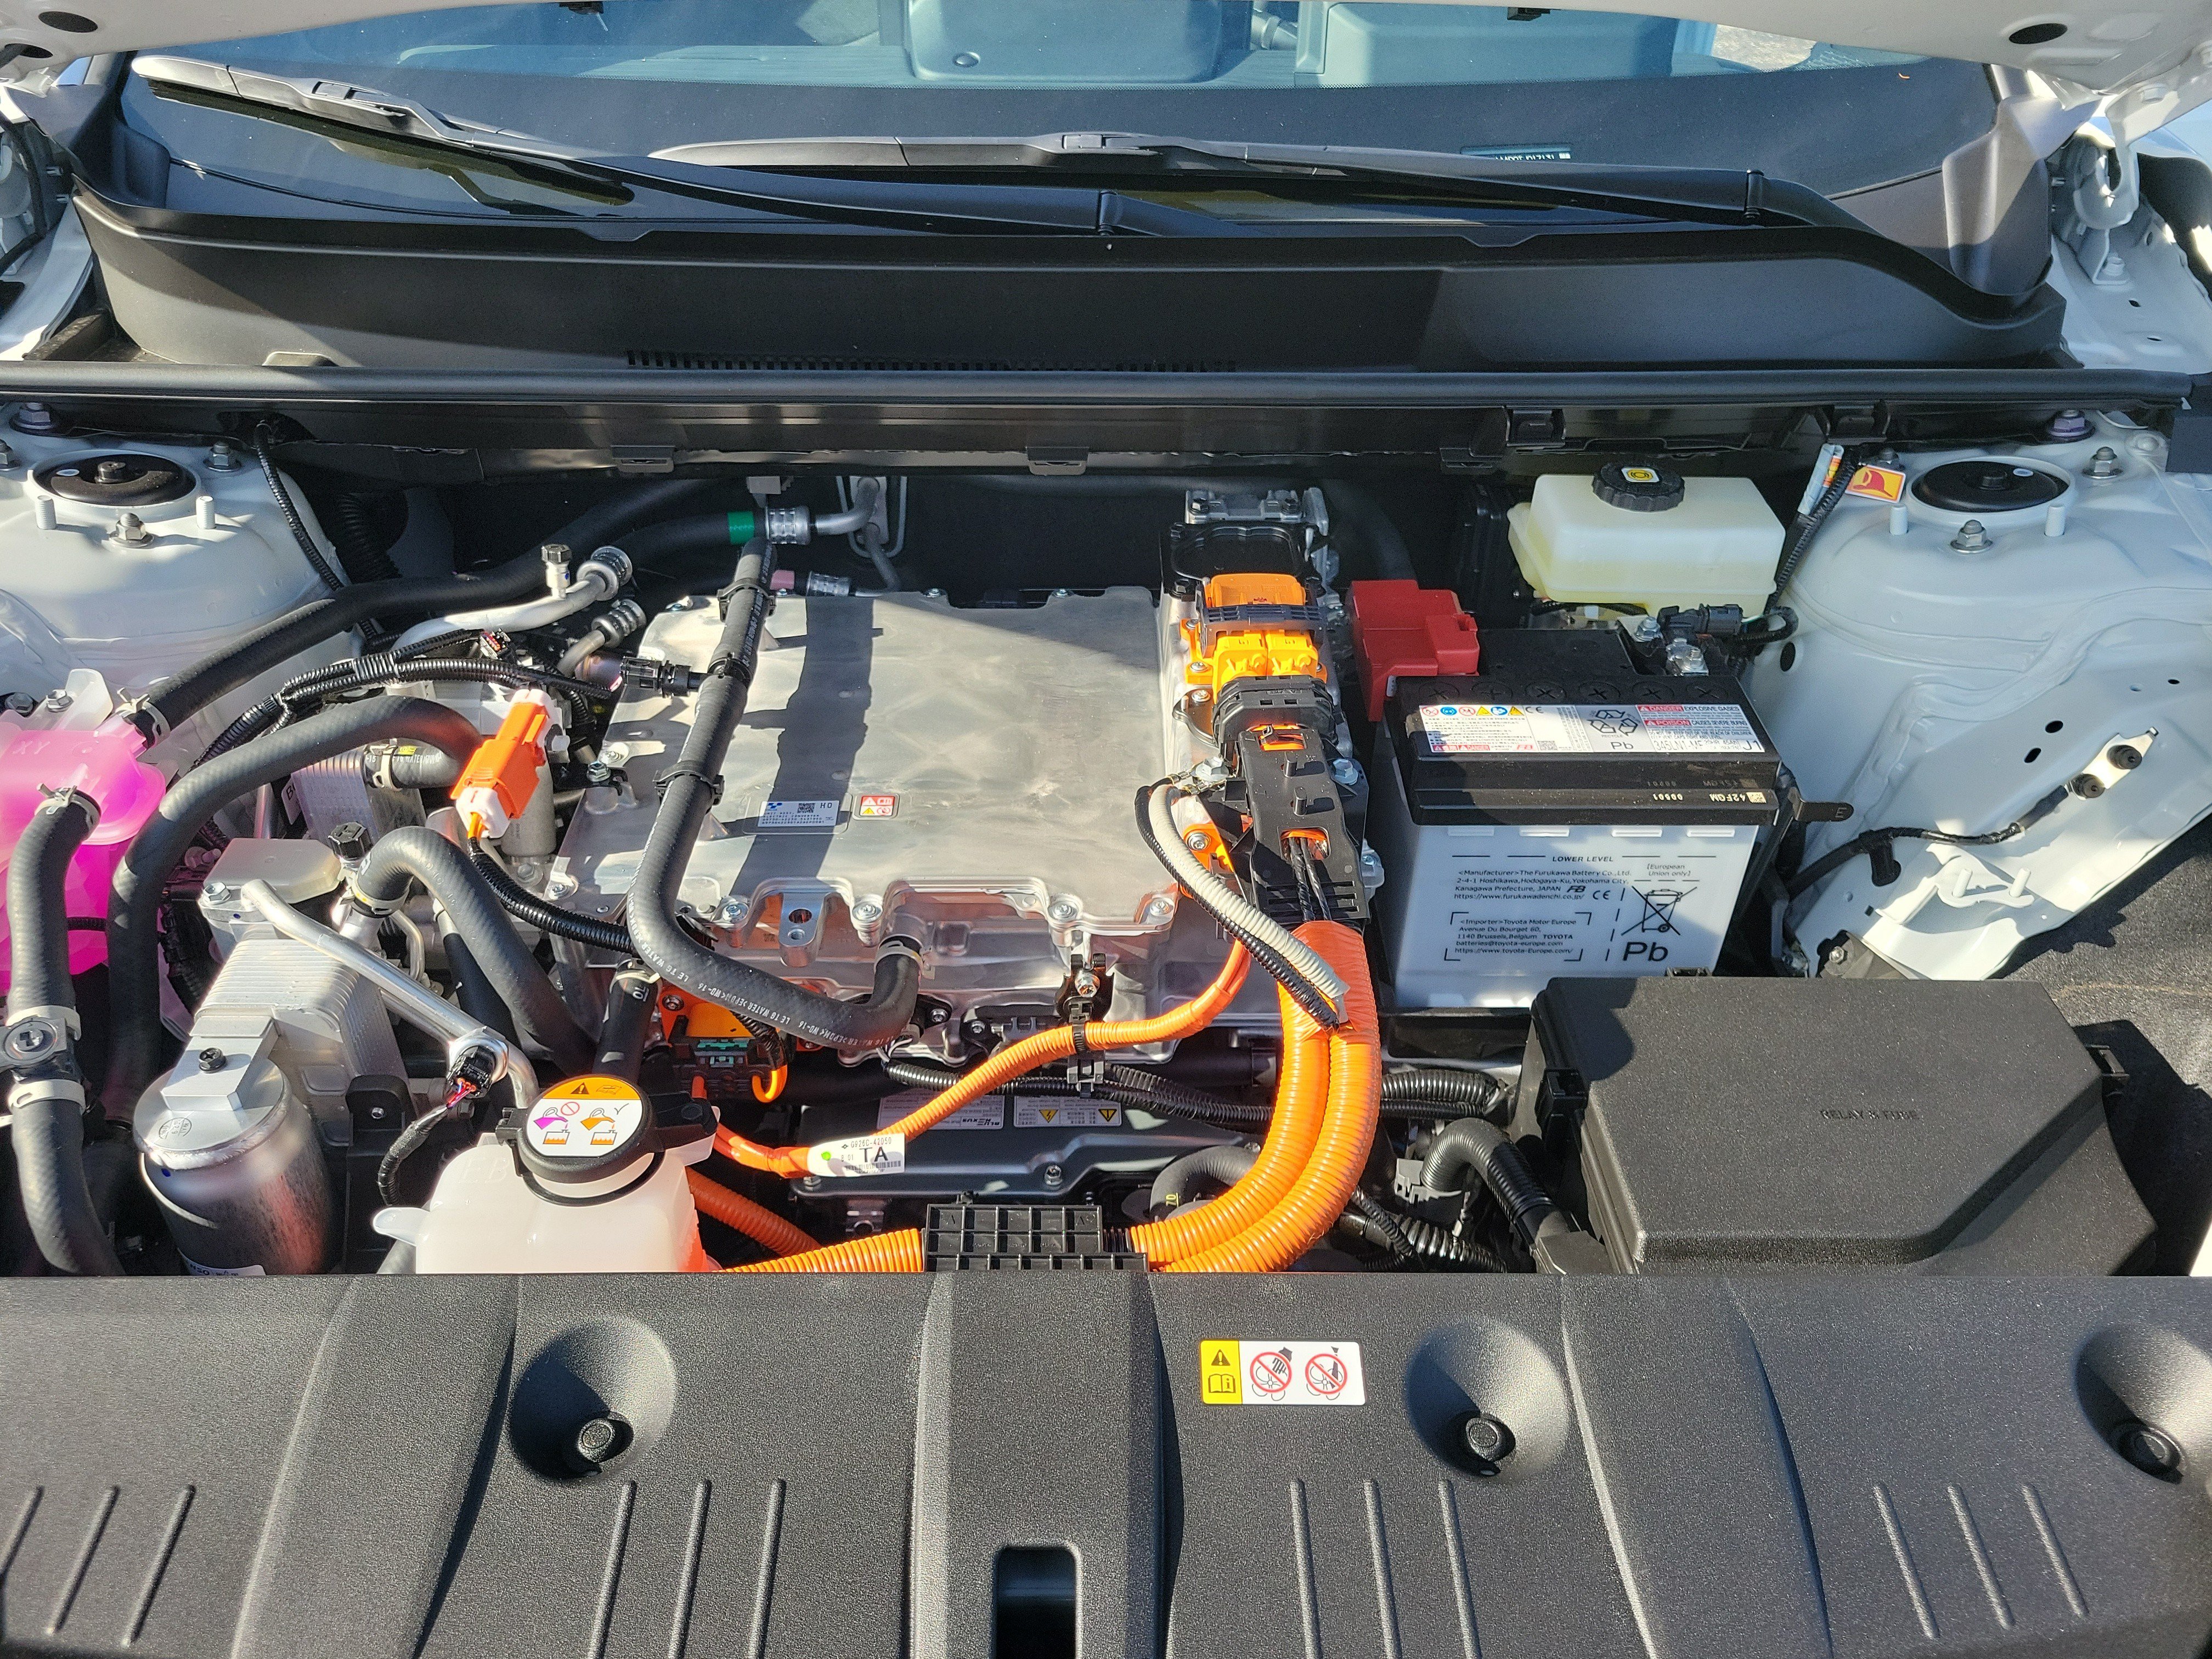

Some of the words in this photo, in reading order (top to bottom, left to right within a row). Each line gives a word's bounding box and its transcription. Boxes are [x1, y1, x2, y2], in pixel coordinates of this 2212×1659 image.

[641, 941, 665, 967] WATER
[1622, 941, 1668, 962] Pb
[665, 964, 677, 975] TG
[677, 971, 689, 983] LE
[747, 1001, 770, 1017] WATER
[770, 1012, 781, 1021] TG
[781, 1015, 791, 1025] LE
[1819, 1109, 1864, 1120] RELAY
[859, 1146, 889, 1163] TA
